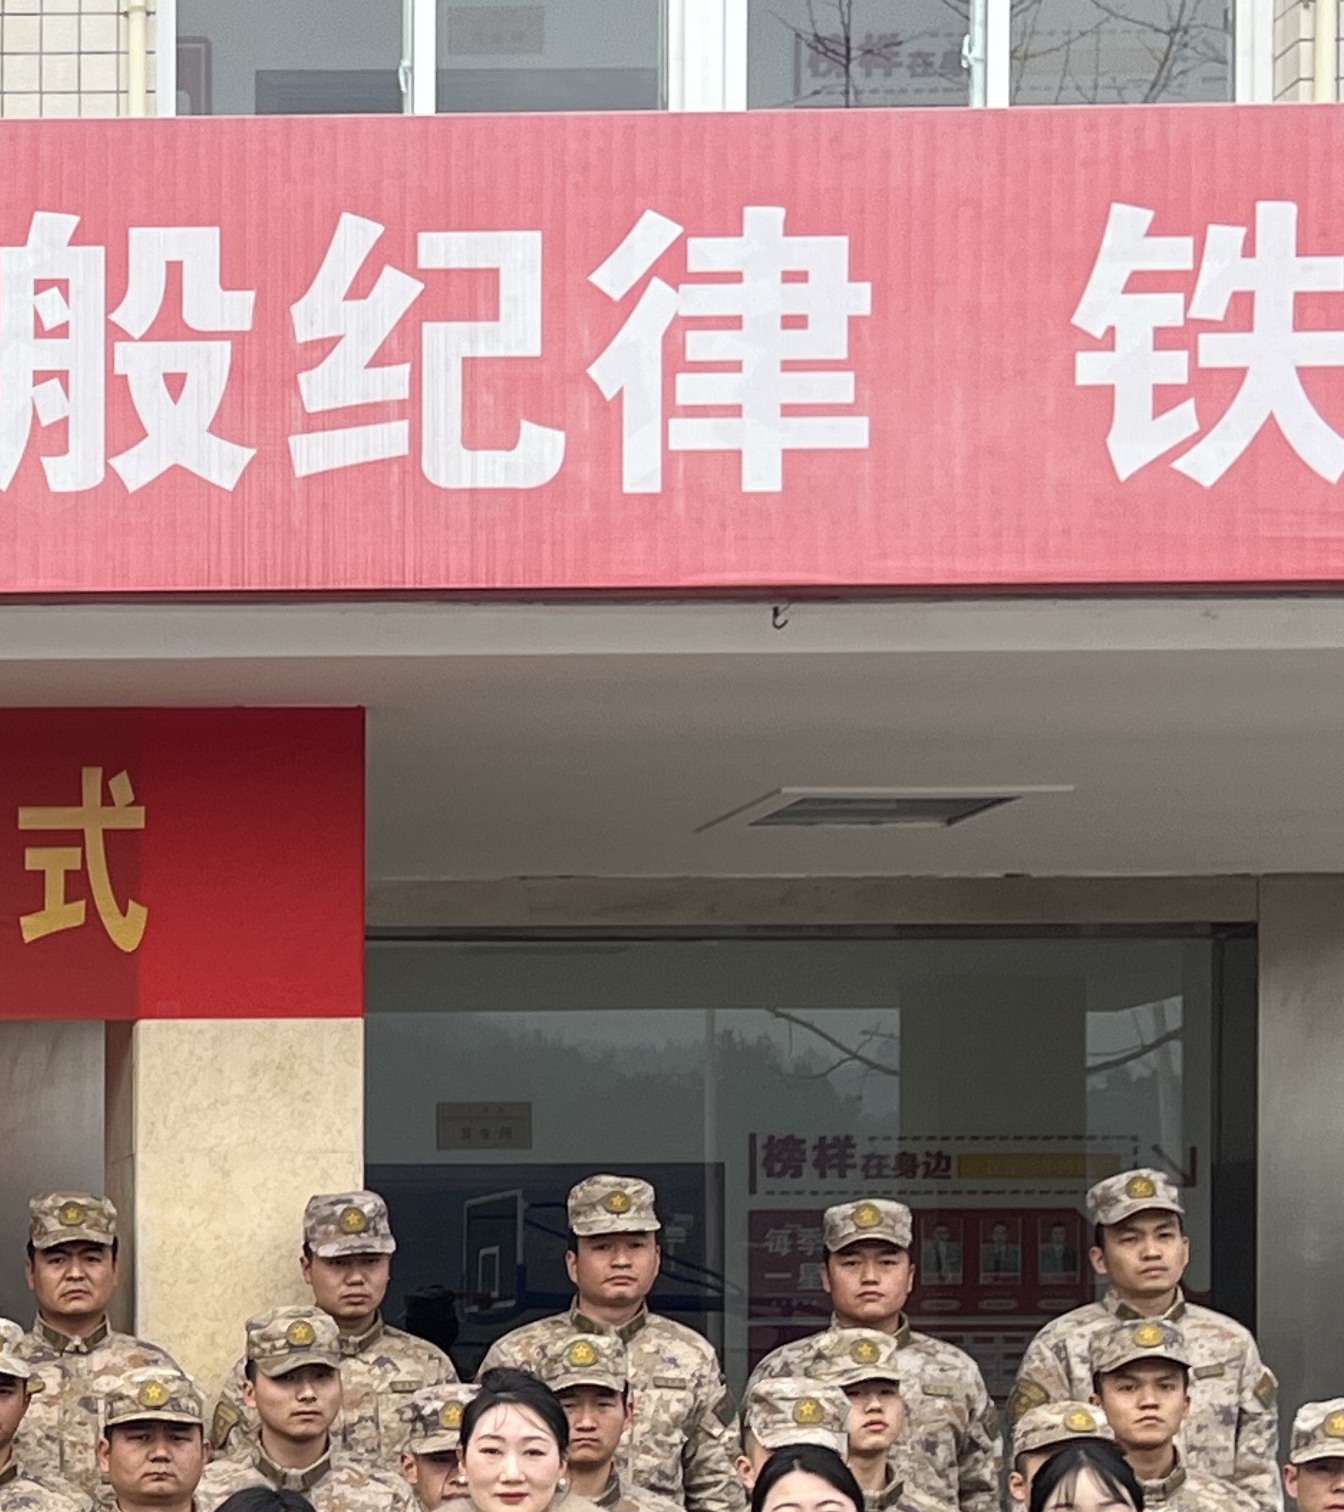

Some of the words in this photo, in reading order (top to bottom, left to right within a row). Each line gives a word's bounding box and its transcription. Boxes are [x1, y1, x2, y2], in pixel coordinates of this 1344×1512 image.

[1069, 200, 1344, 488] 铁
[761, 1133, 952, 1180] 榜样在身边
